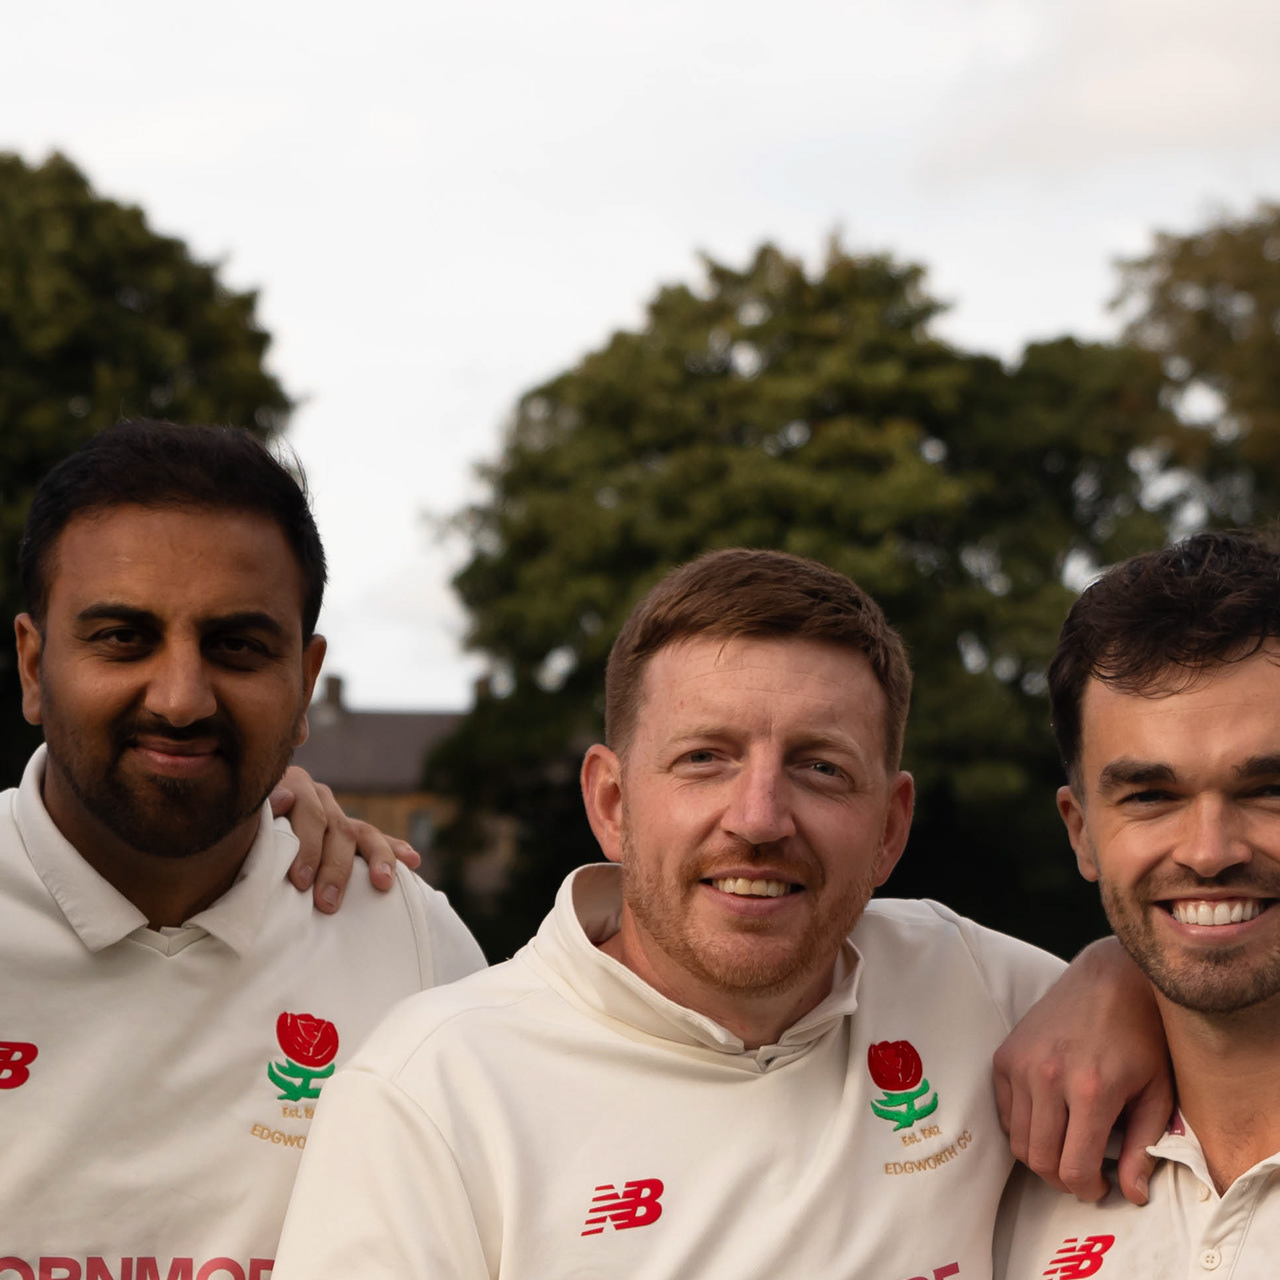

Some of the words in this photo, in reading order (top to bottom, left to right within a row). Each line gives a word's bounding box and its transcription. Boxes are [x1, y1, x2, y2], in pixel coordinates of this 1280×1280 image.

[250, 1123, 307, 1150] EDGWO
[883, 1145, 959, 1175] EDGWORTH
[957, 1130, 973, 1150] CC
